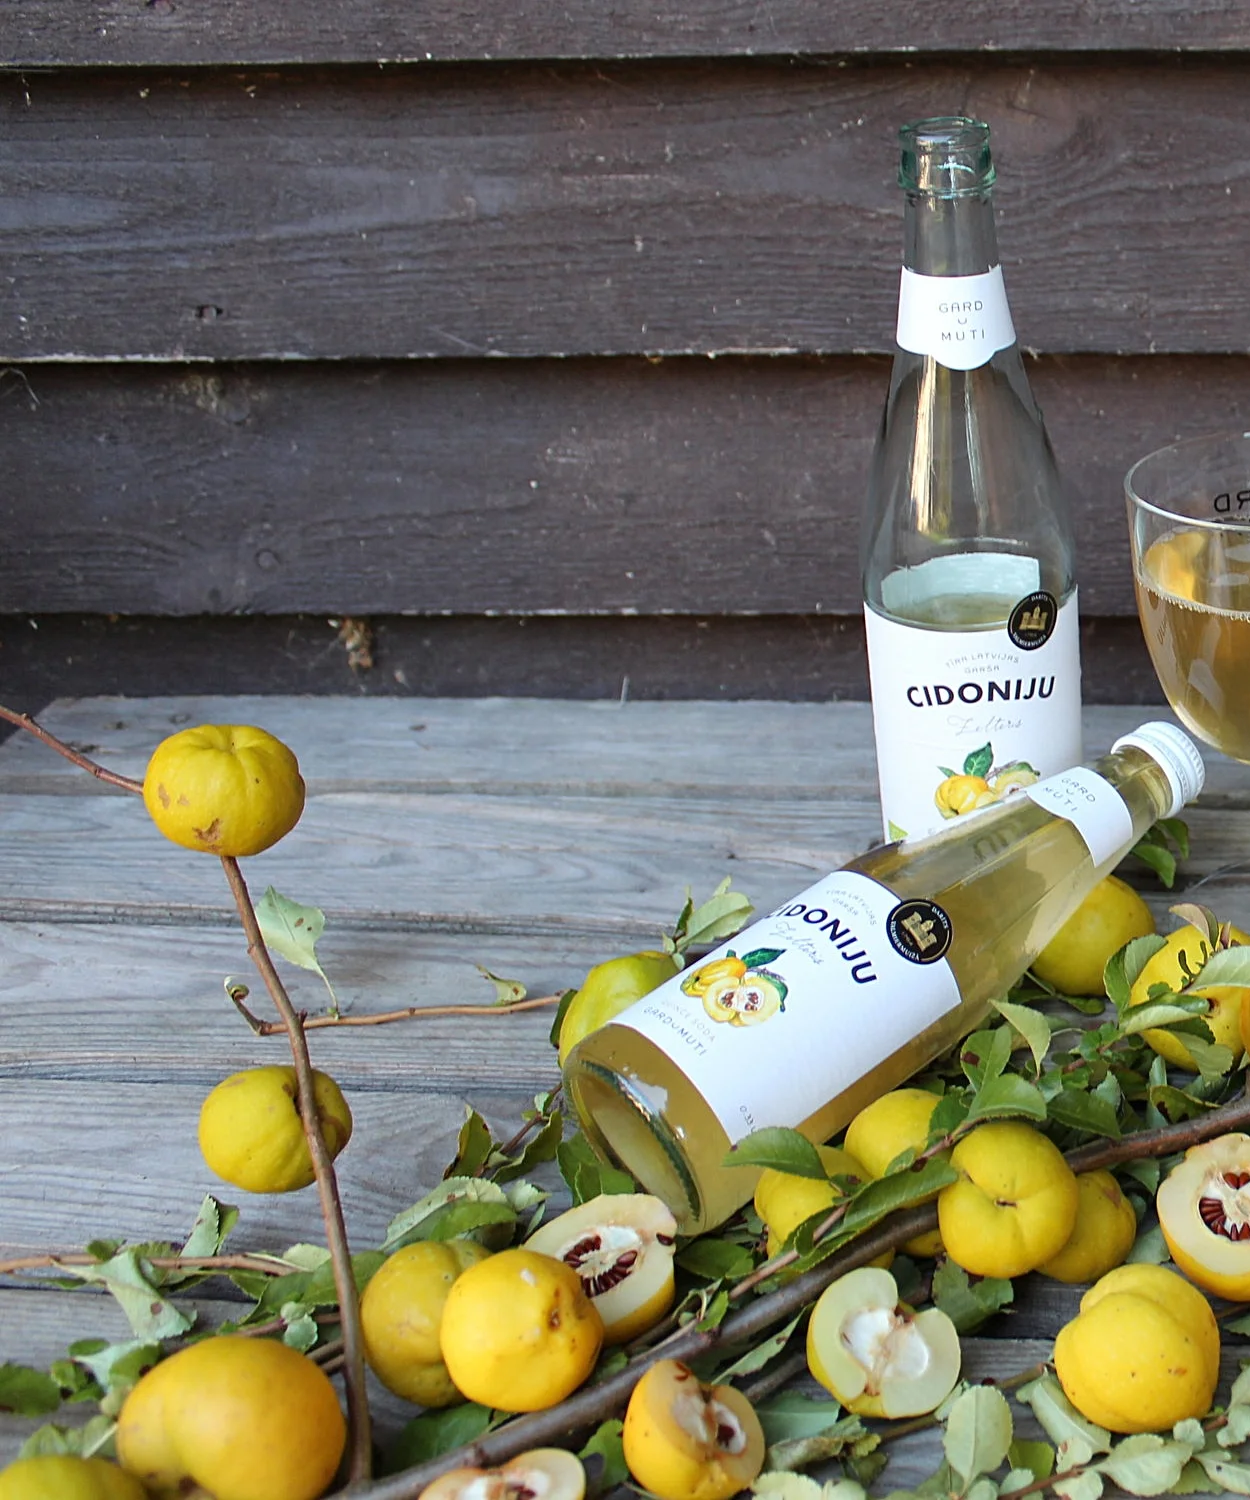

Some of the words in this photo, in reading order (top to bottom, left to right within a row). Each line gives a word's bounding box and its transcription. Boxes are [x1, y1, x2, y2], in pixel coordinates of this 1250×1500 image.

[938, 300, 983, 313] GARD
[941, 328, 985, 341] MUTI
[906, 675, 1056, 708] CIDONIJU
